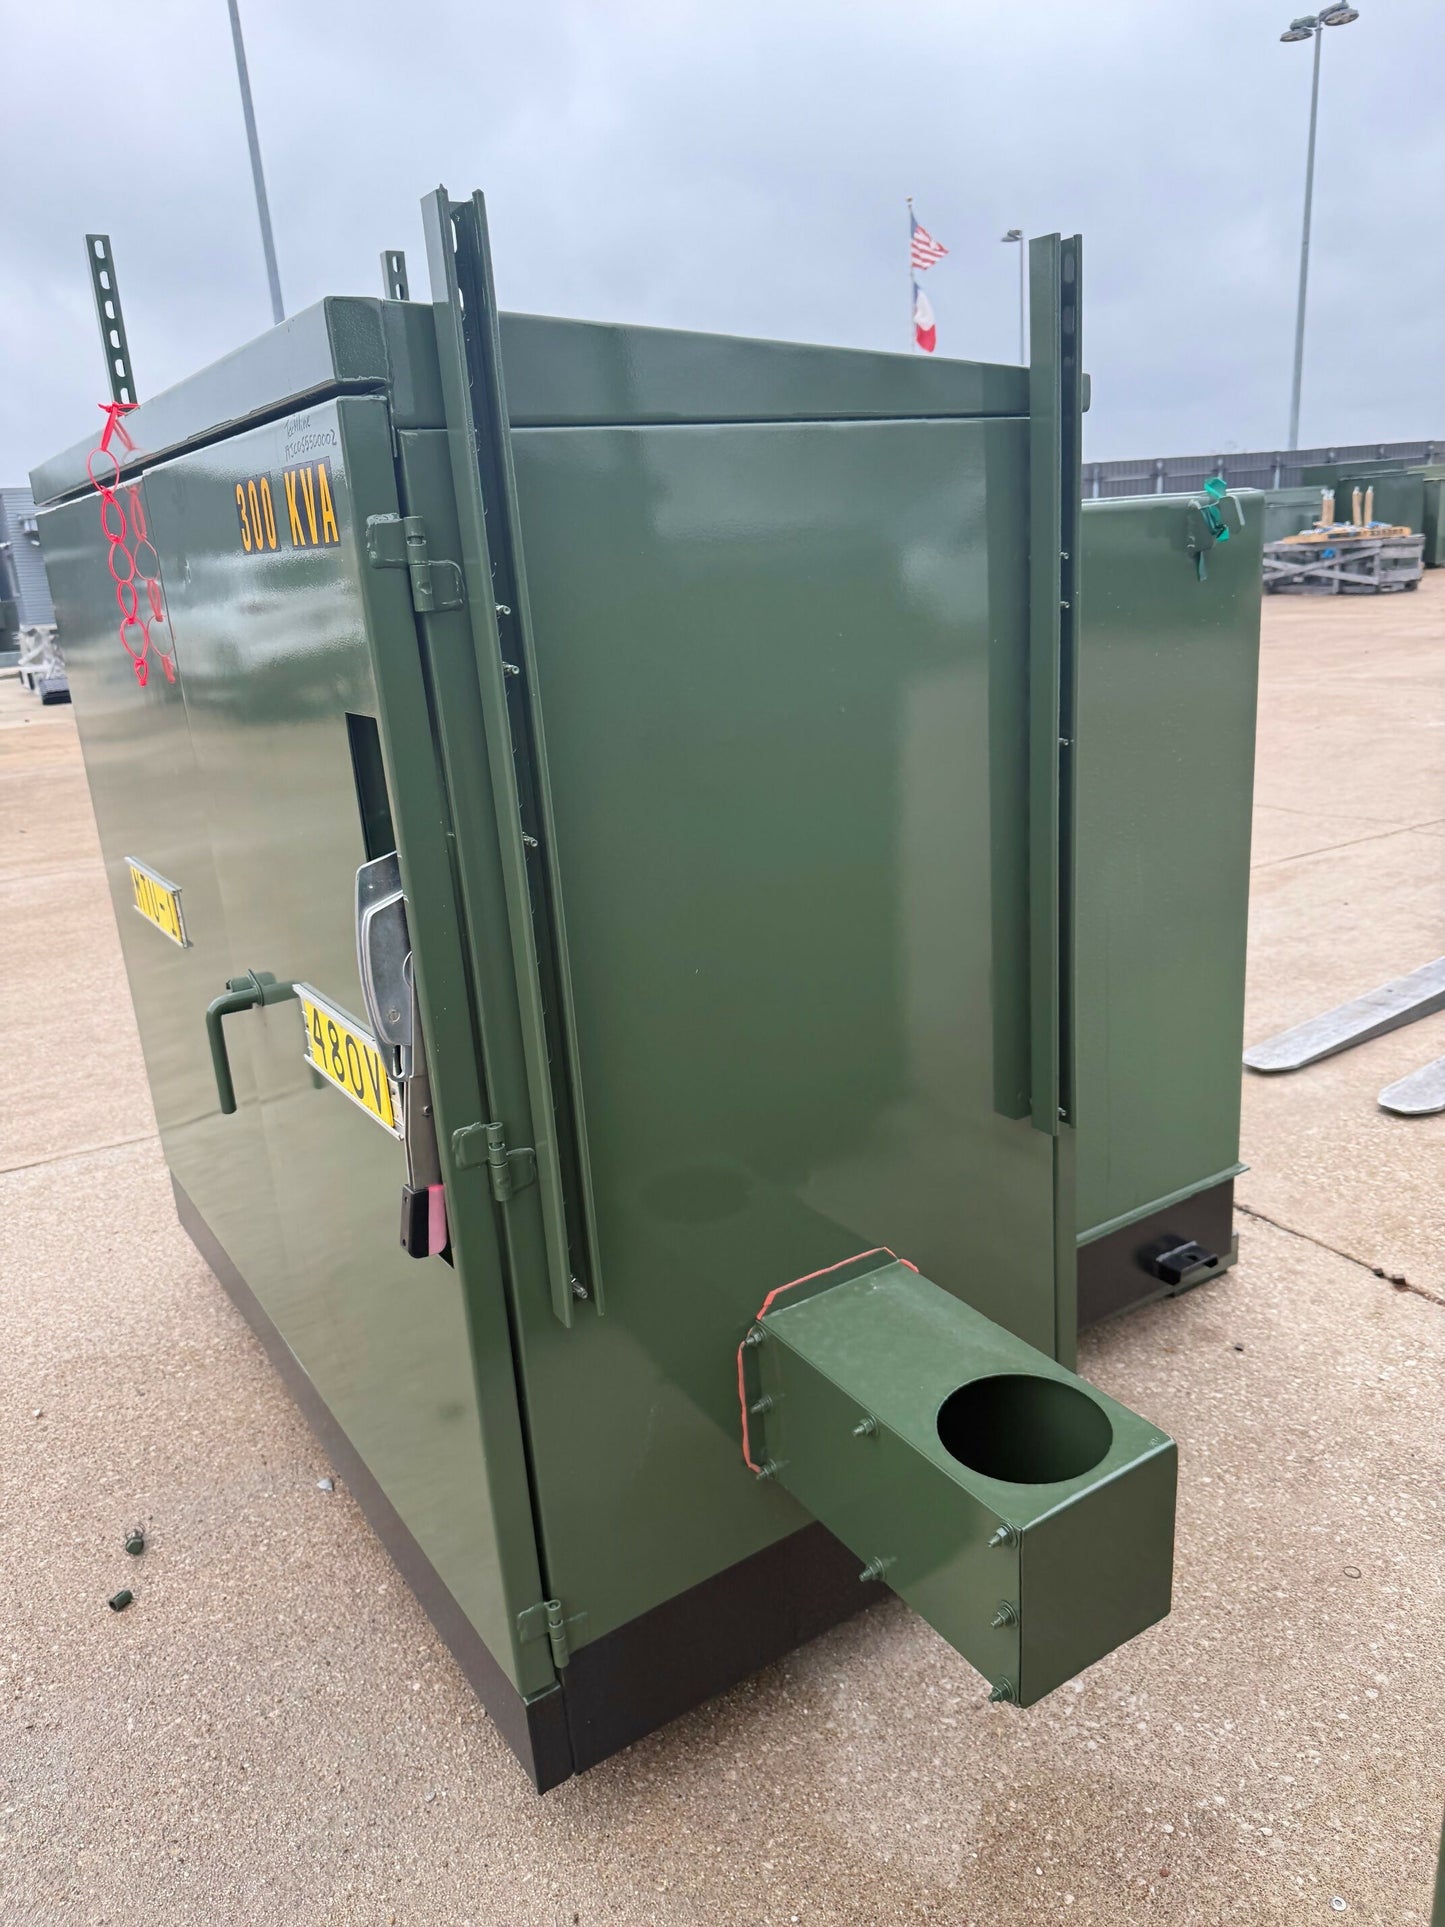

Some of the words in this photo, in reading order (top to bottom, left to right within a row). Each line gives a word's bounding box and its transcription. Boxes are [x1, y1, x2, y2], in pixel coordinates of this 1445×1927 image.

[236, 477, 277, 552] 300
[284, 463, 339, 546] KVA
[313, 1007, 382, 1115] 480V
